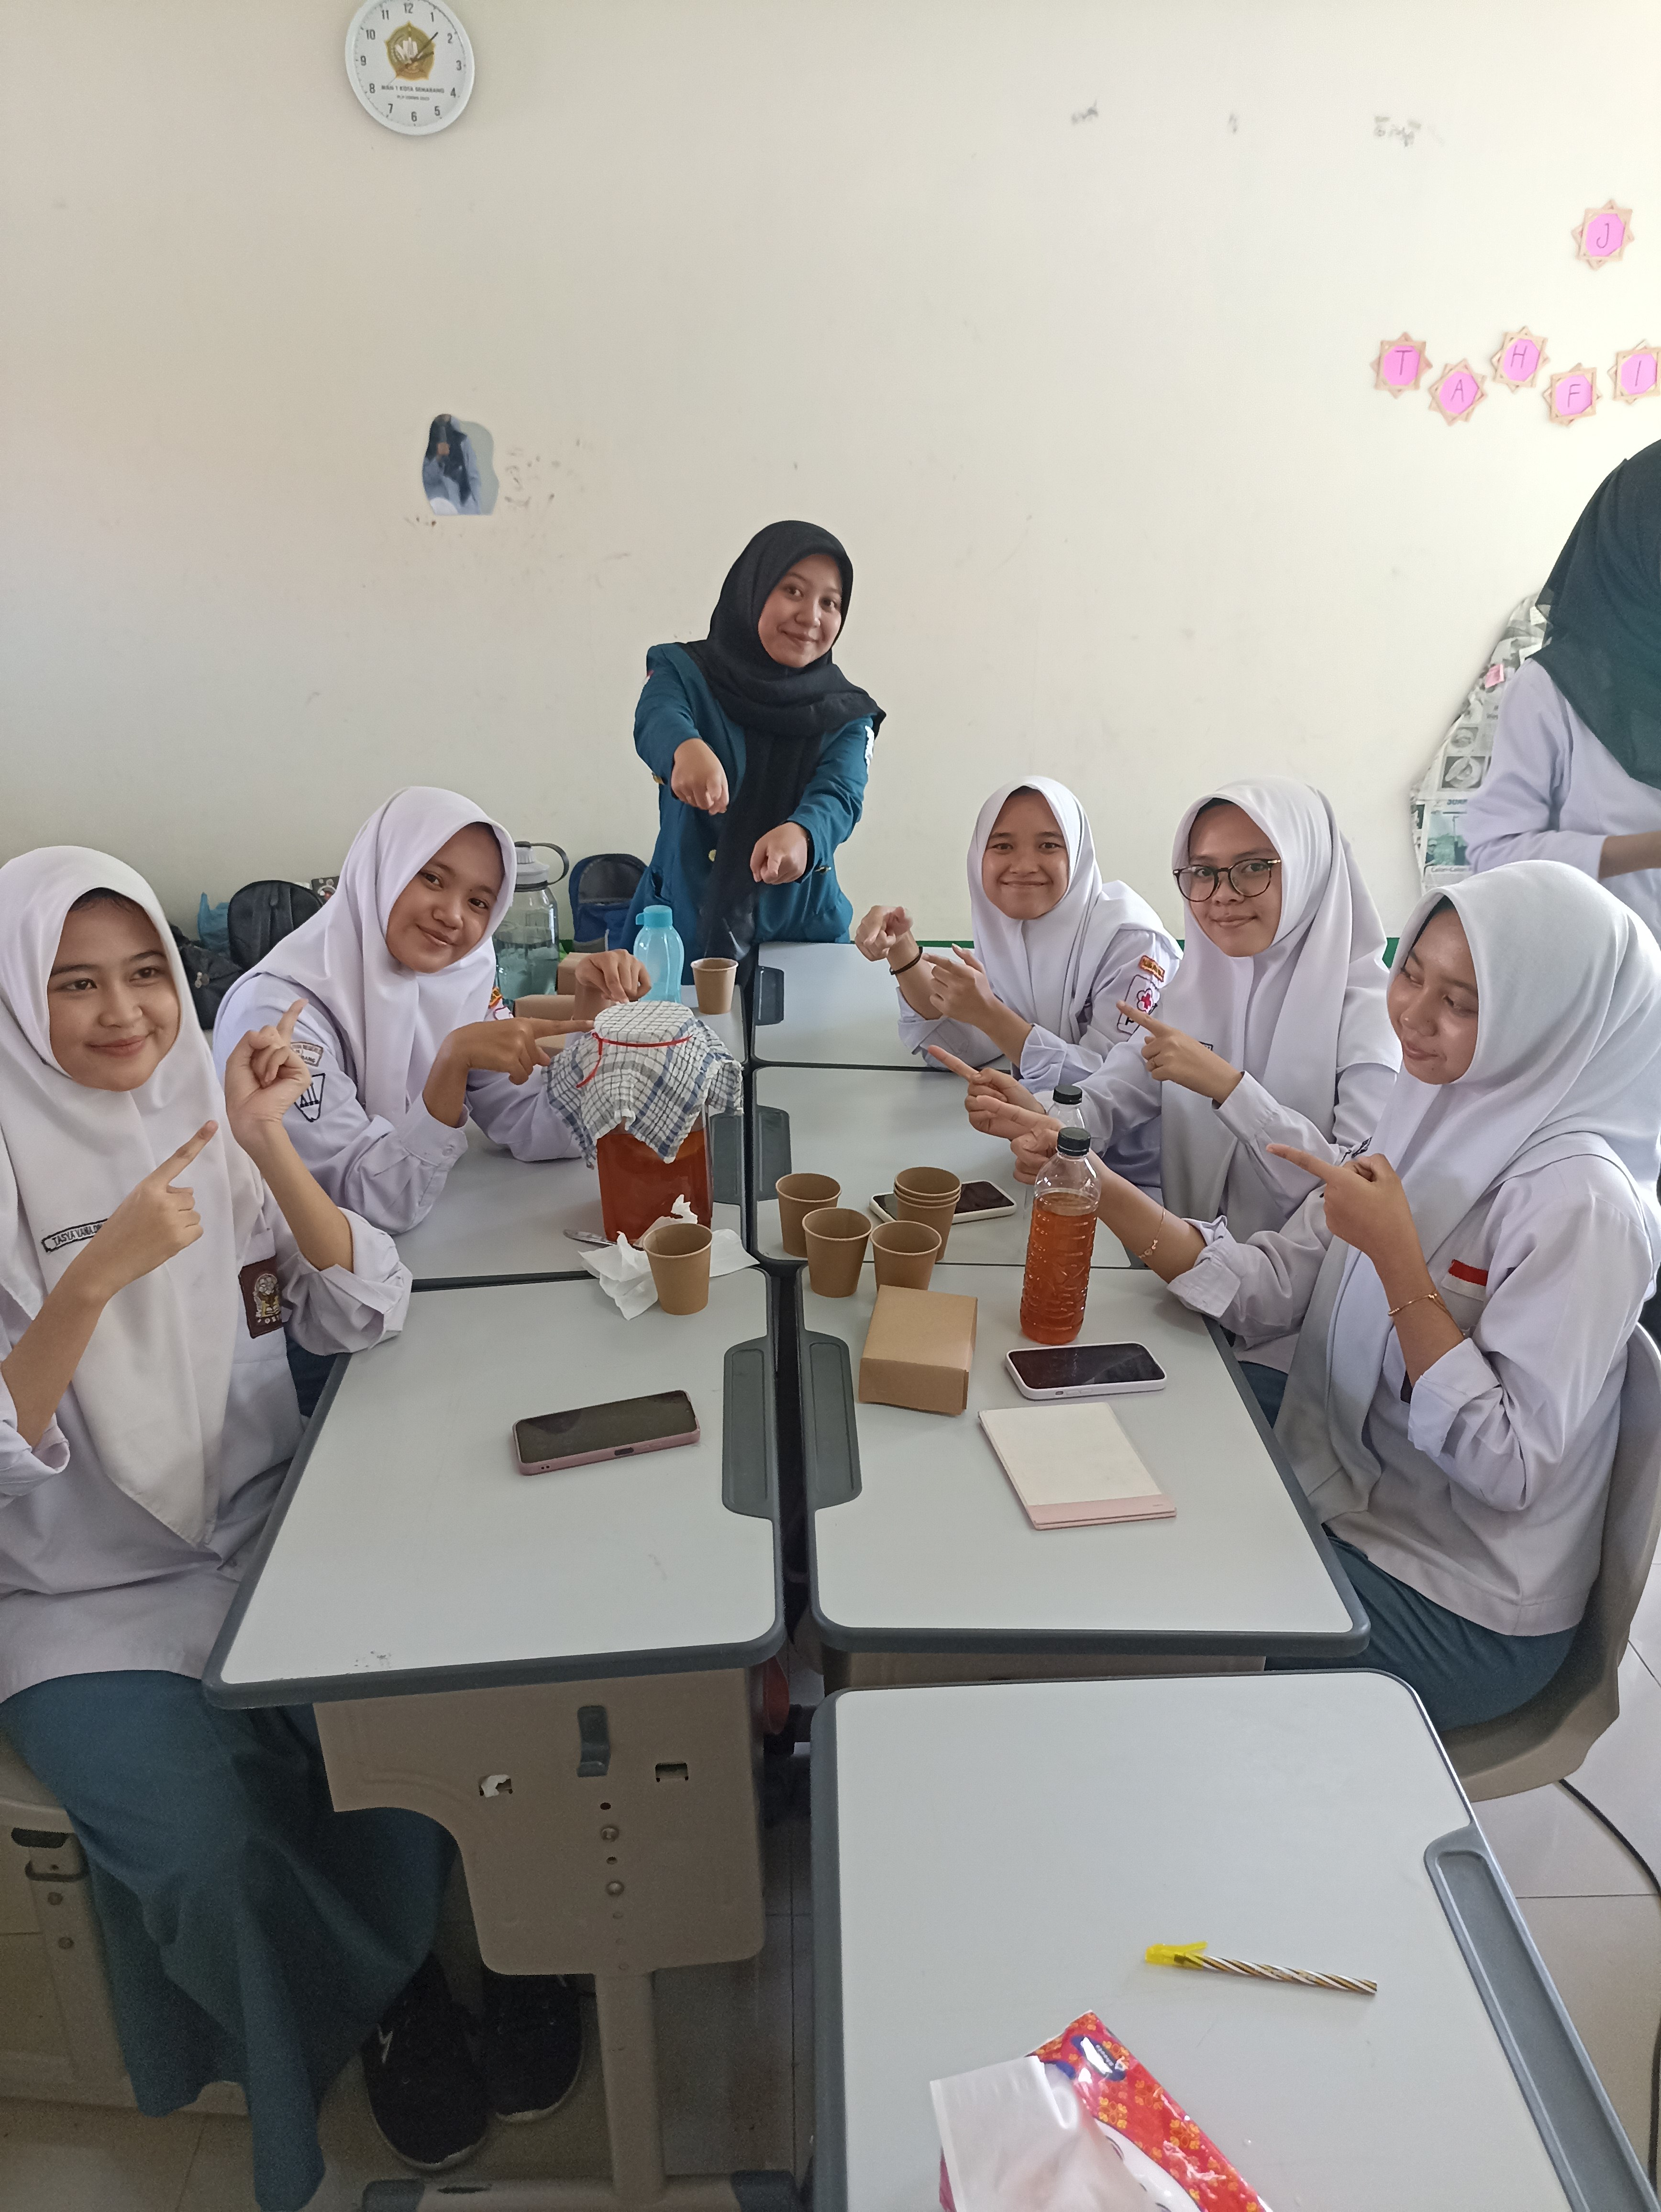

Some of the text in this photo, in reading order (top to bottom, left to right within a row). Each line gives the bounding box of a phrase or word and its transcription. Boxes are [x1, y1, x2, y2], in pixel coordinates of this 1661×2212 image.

[404, 2, 413, 13] 12
[382, 10, 389, 20] 11
[431, 12, 434, 22] 1
[366, 29, 376, 40] 10
[447, 33, 453, 44] 2
[360, 55, 366, 66] 9
[456, 60, 462, 71] 3
[369, 83, 376, 93] 8
[450, 88, 456, 98] 4
[388, 103, 393, 114] 7
[434, 106, 440, 116] 5
[411, 111, 417, 122] 6
[1596, 222, 1610, 249] J
[52, 1230, 76, 1246] TASYA
